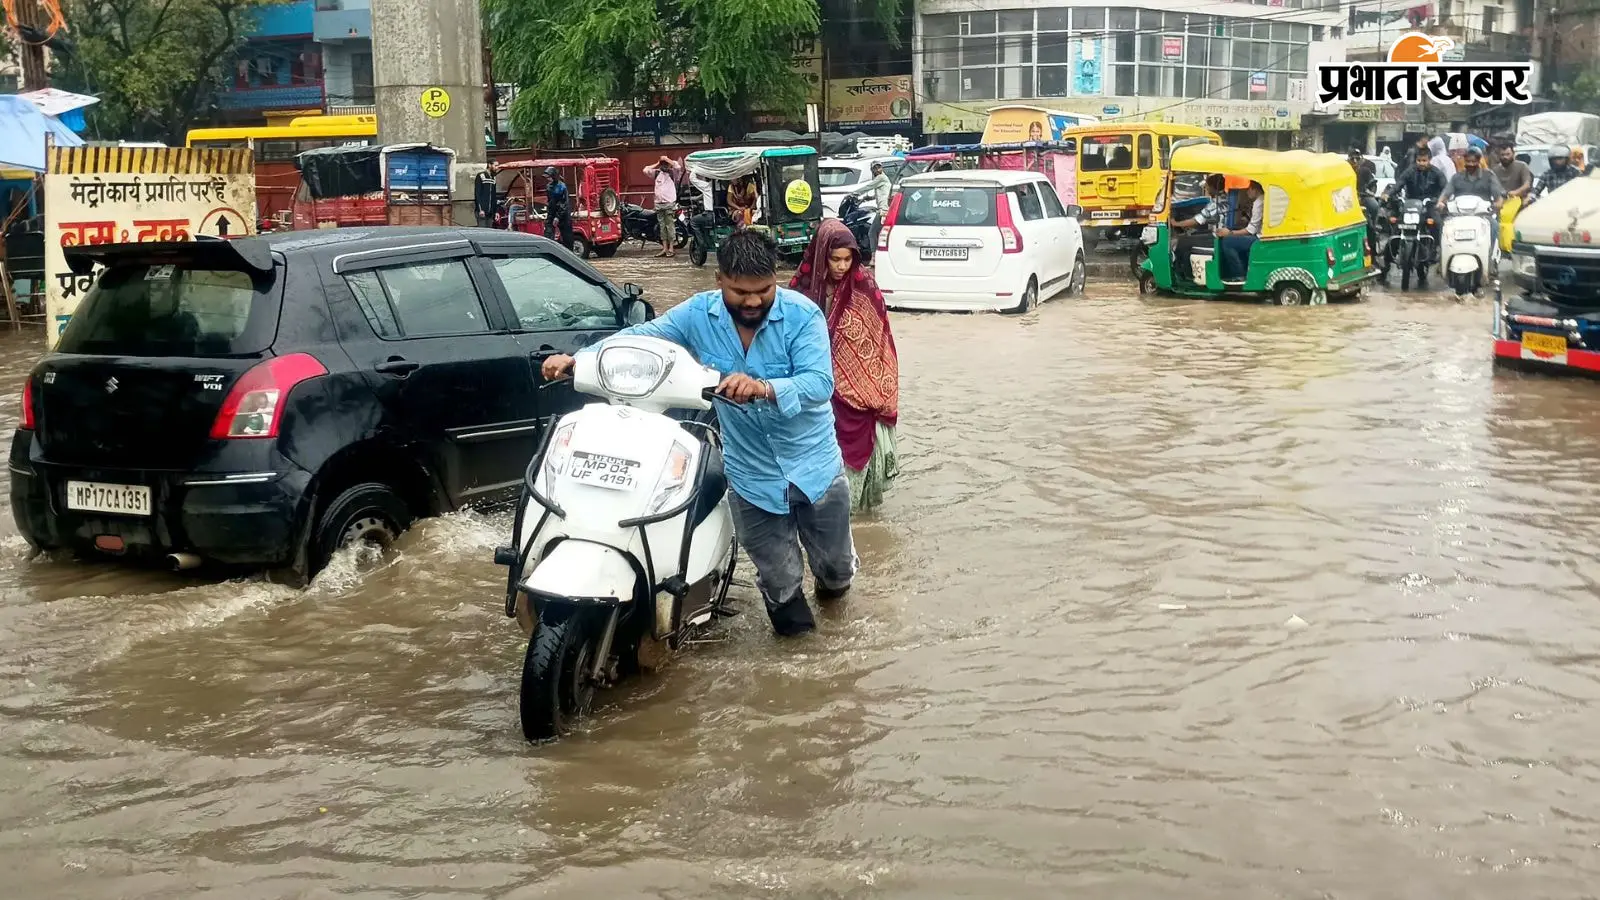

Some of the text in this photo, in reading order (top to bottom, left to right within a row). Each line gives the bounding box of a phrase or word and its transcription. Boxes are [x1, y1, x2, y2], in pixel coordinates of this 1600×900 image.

[430, 90, 442, 100] P
[425, 102, 447, 112] 250
[70, 177, 106, 208] मेट्रो
[106, 177, 141, 204] कार्य
[144, 176, 187, 203] प्रगति
[932, 200, 962, 208] BAGHEL
[203, 383, 223, 391] VDI
[583, 460, 630, 475] MP 04
[571, 468, 633, 486] UF 4191
[76, 487, 148, 511] MP17CA1351
